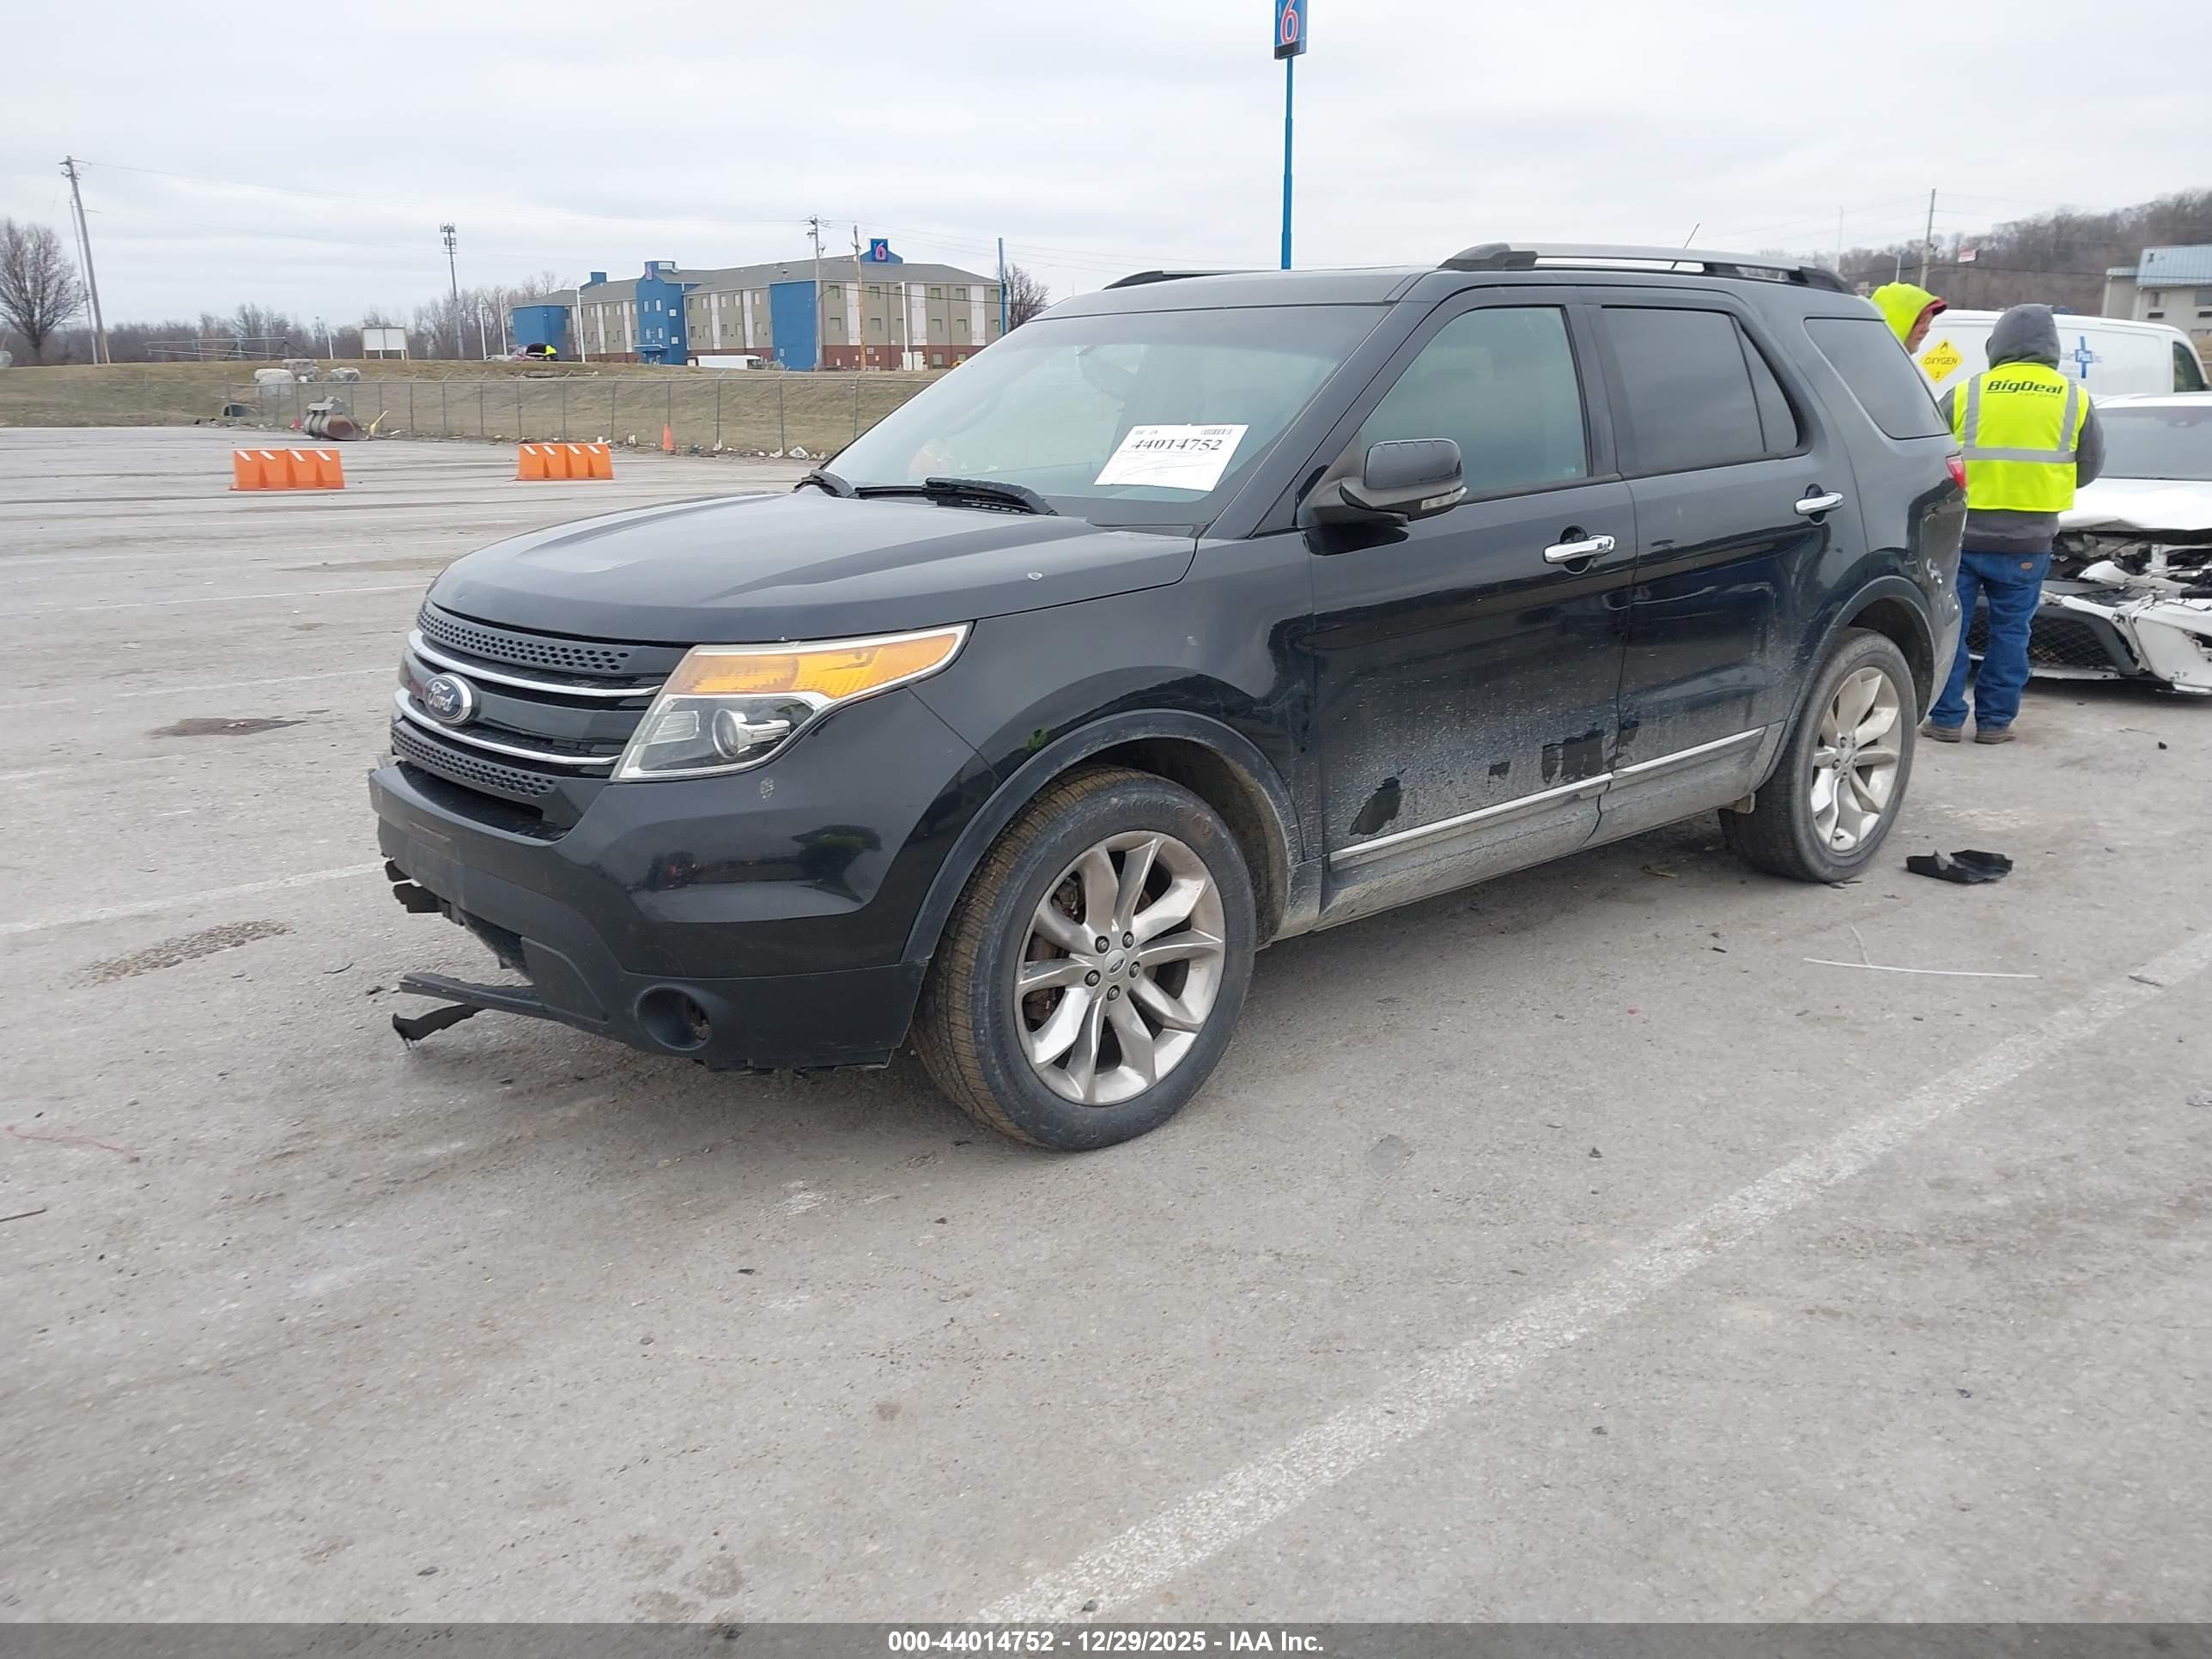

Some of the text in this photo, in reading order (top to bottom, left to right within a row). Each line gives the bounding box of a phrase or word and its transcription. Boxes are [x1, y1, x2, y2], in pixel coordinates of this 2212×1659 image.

[1280, 0, 1298, 44] 6
[875, 242, 887, 261] 6
[1924, 356, 1958, 365] OXYGEN
[1986, 379, 2063, 394] BigDeal
[1131, 438, 1224, 451] 44014752
[428, 681, 455, 712] Ford
